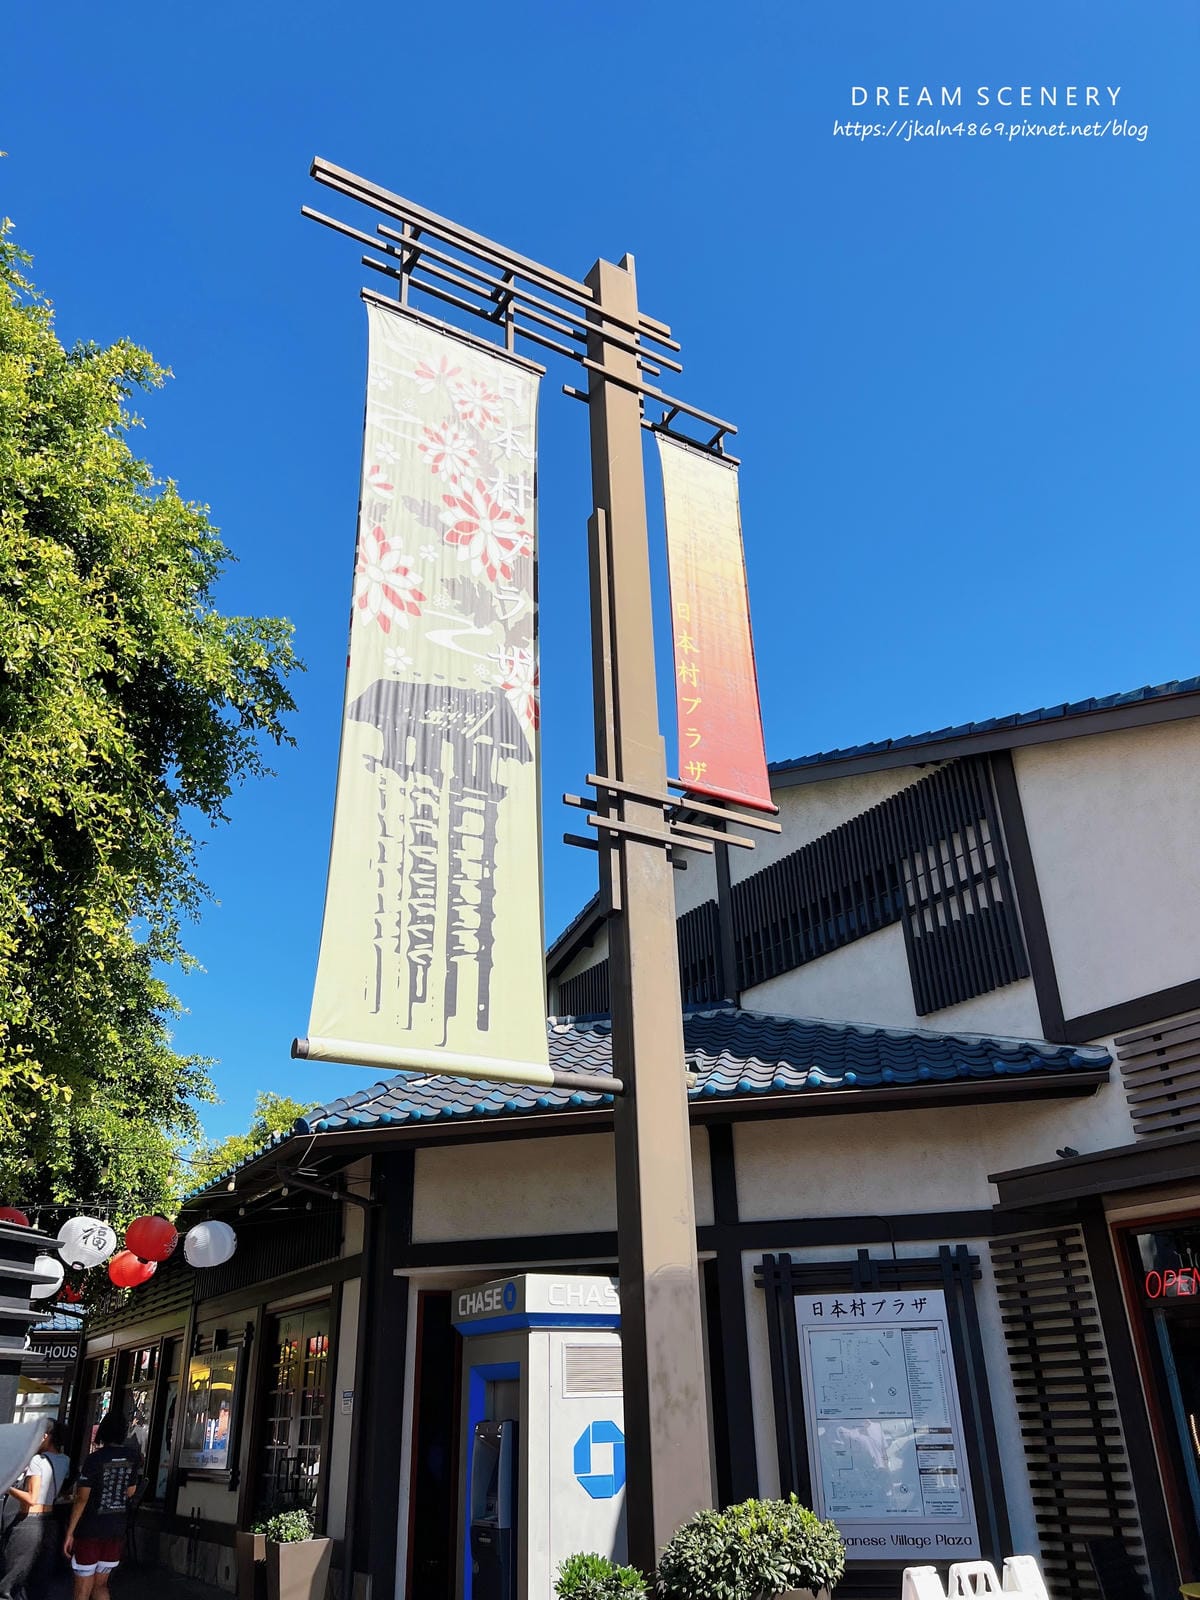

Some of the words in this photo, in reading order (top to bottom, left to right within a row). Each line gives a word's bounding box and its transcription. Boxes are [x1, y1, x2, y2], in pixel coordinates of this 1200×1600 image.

[676, 602, 708, 783] 日本村プラザ
[458, 1287, 502, 1316] CHASE
[549, 1283, 619, 1307] CHAS
[812, 1297, 927, 1318] 日本村プラザ
[44, 1345, 79, 1358] HOUS
[890, 1533, 932, 1549] Village
[935, 1533, 973, 1546] Plaza
